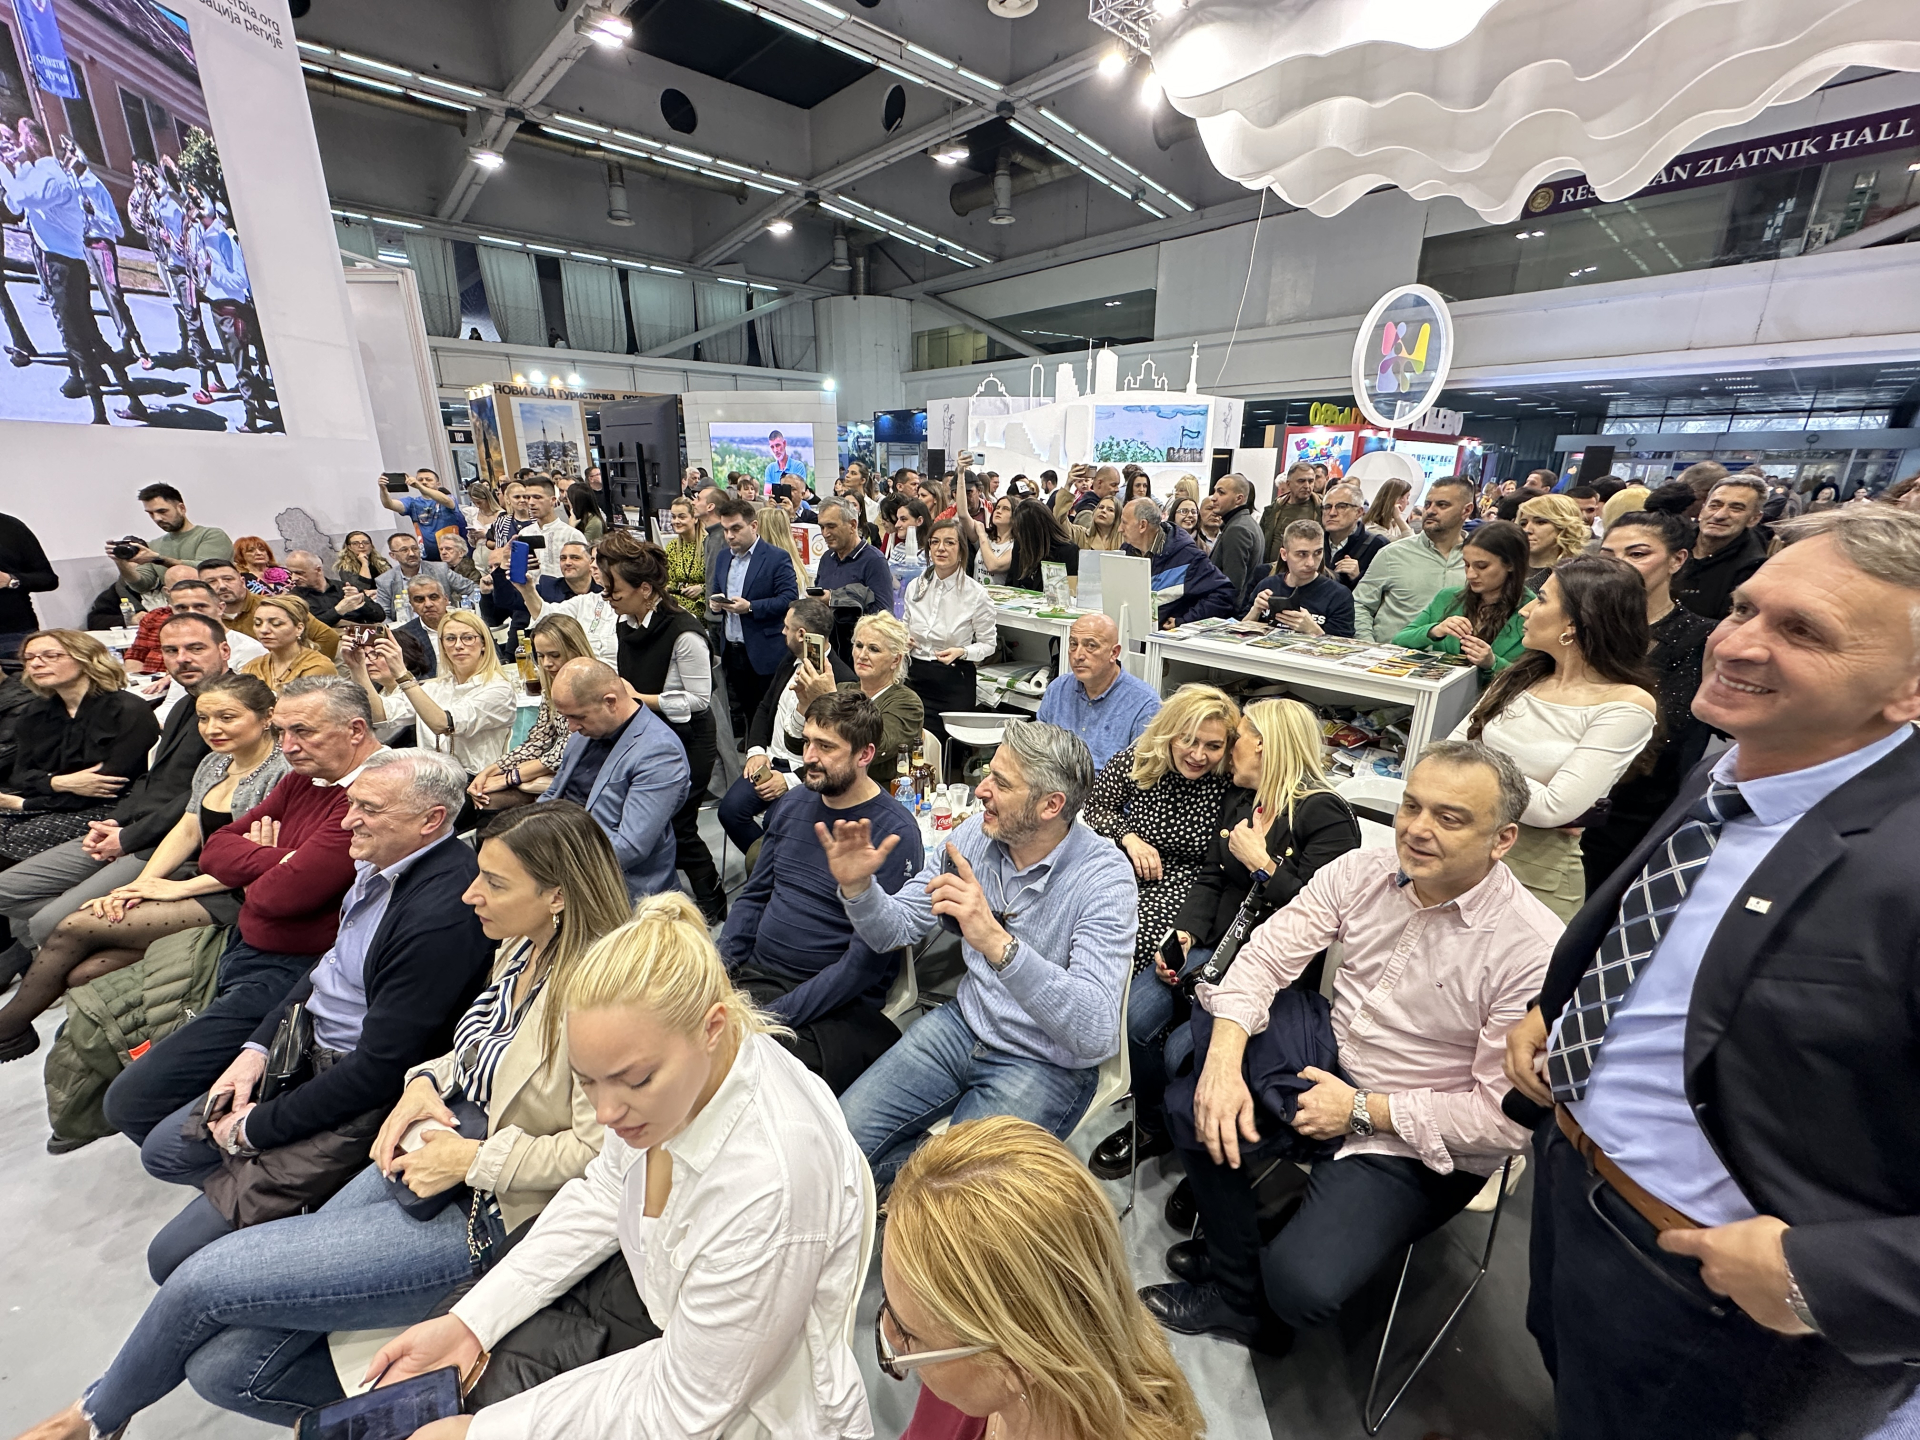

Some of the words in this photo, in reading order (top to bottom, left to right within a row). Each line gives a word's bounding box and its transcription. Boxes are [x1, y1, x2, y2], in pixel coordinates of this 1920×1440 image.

[244, 18, 283, 49] регије
[1694, 136, 1821, 178] ZLATNIK
[1826, 117, 1914, 151] HALL
[493, 384, 528, 396] НОВИ
[530, 386, 556, 399] САД
